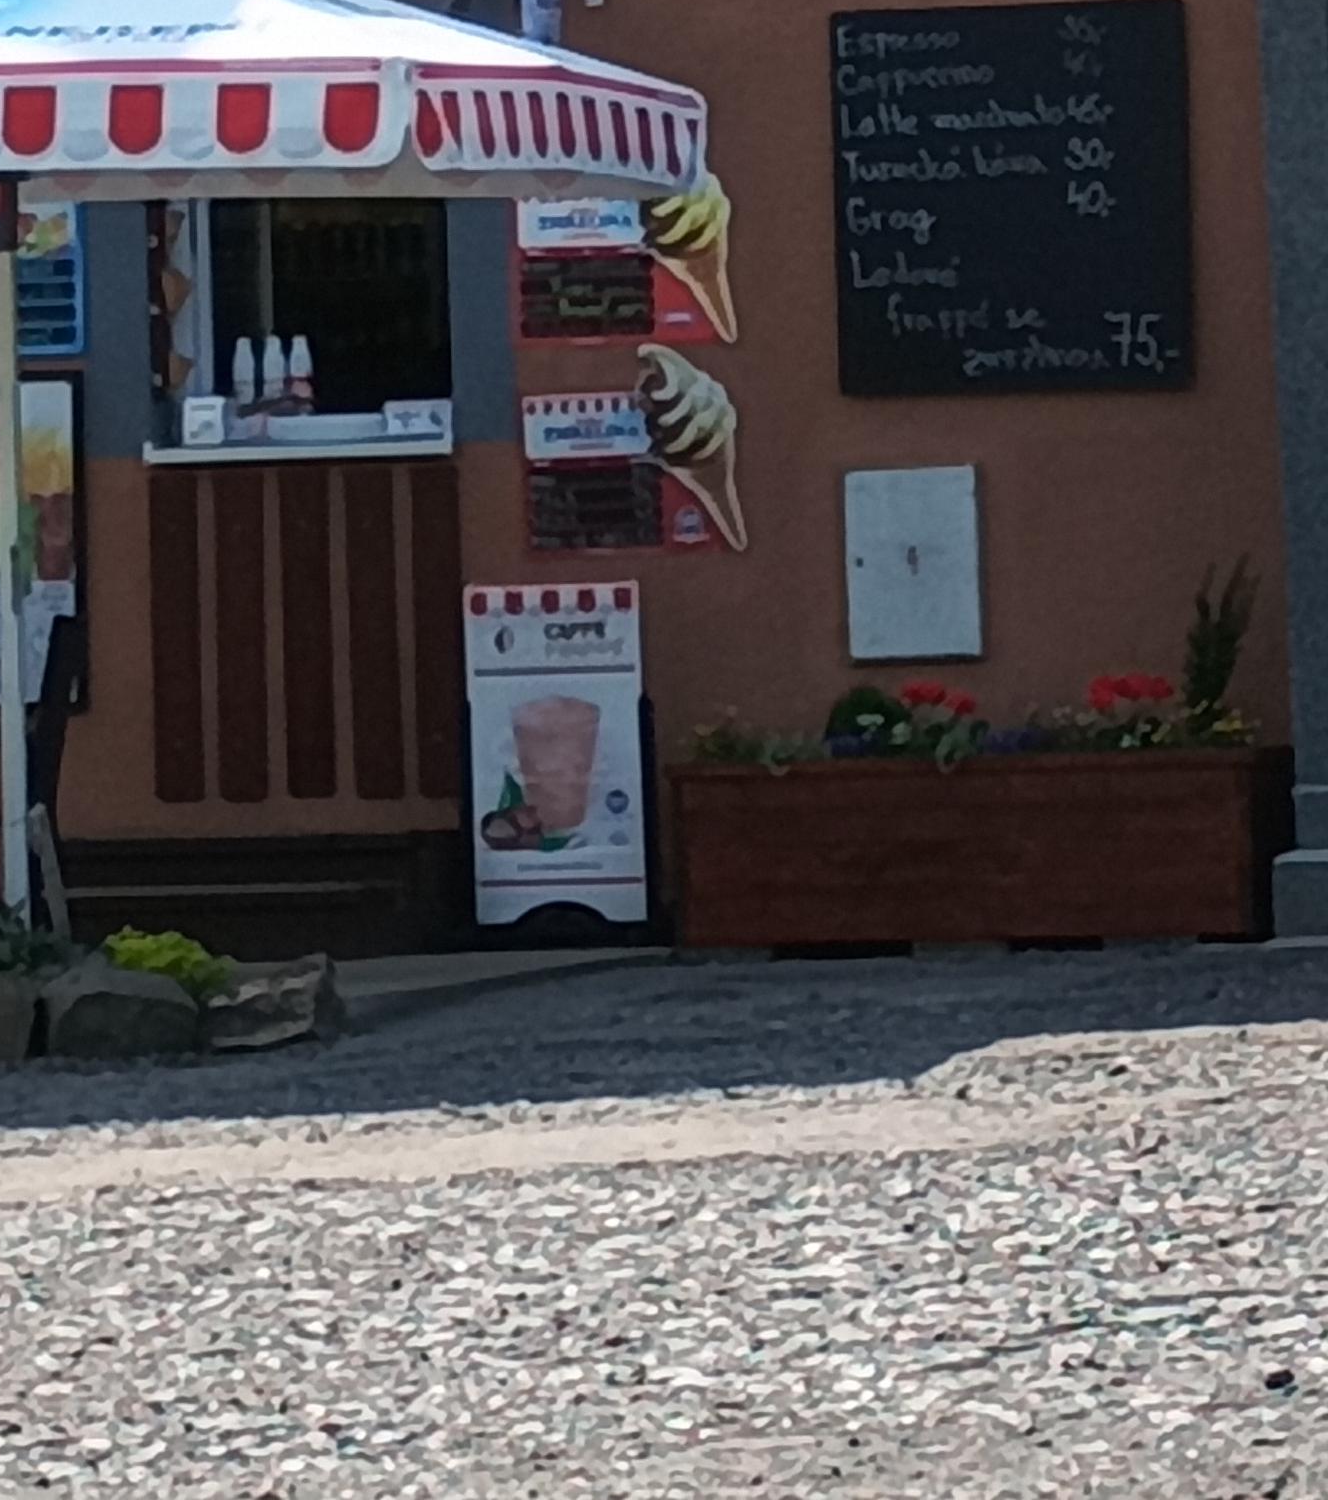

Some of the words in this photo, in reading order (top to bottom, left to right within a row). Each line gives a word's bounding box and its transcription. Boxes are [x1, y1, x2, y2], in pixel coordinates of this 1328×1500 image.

[841, 102, 918, 139] Latte
[846, 197, 936, 245] Grog
[1104, 312, 1180, 373] 75,-
